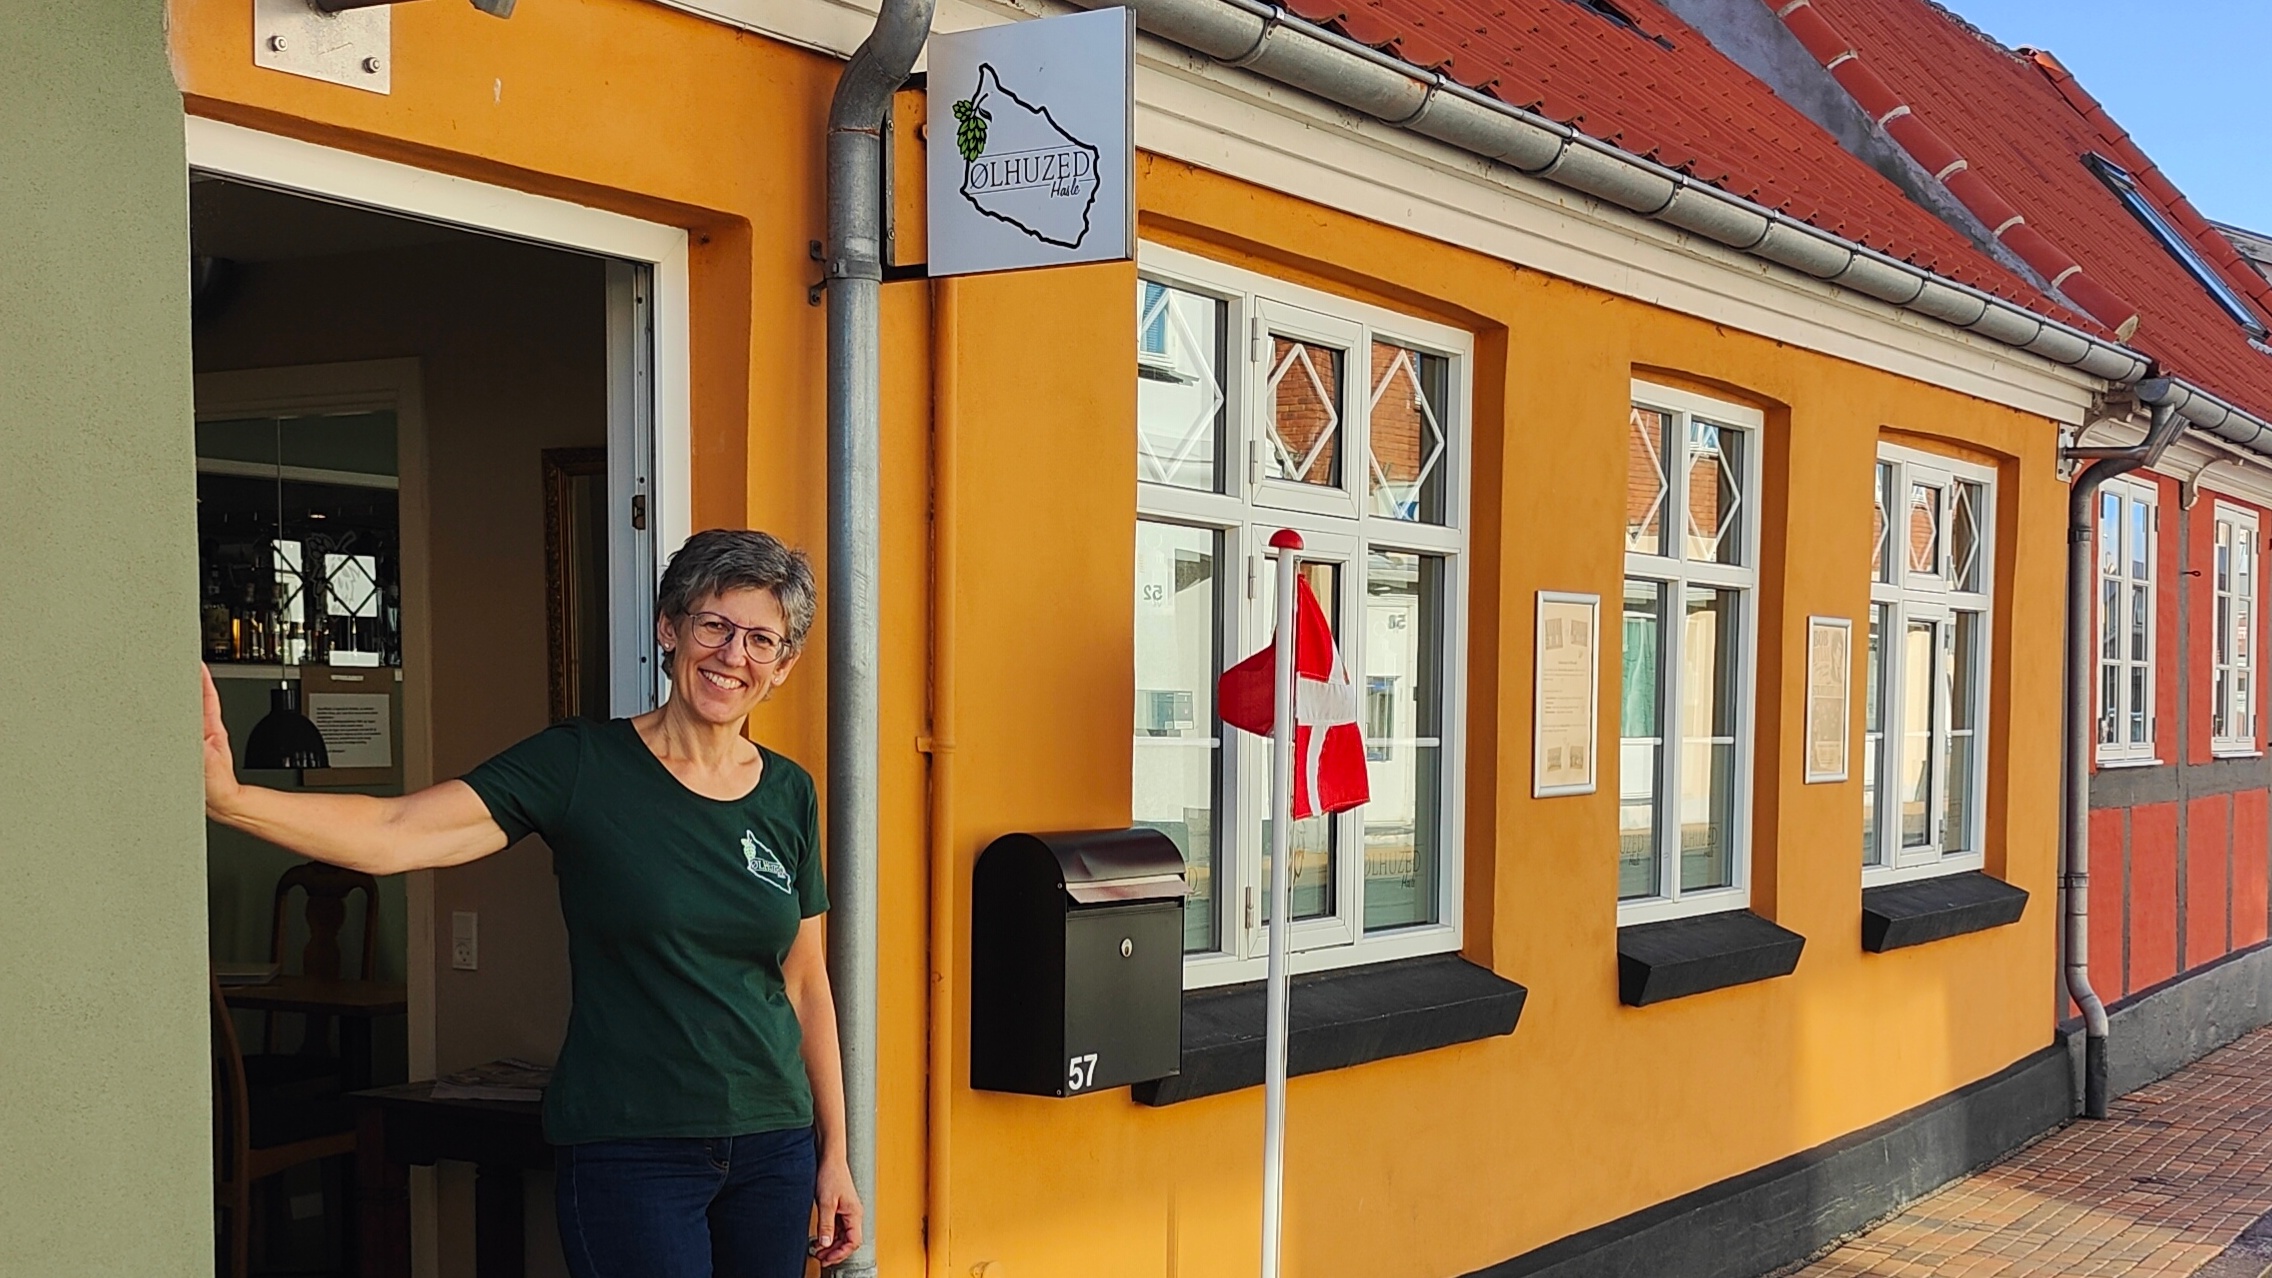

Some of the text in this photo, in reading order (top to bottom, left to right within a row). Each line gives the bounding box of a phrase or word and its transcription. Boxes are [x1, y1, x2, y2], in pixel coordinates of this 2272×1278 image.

[970, 151, 1090, 189] ØLHUZED
[1050, 177, 1080, 198] Hasle
[1068, 1053, 1098, 1091] 57
